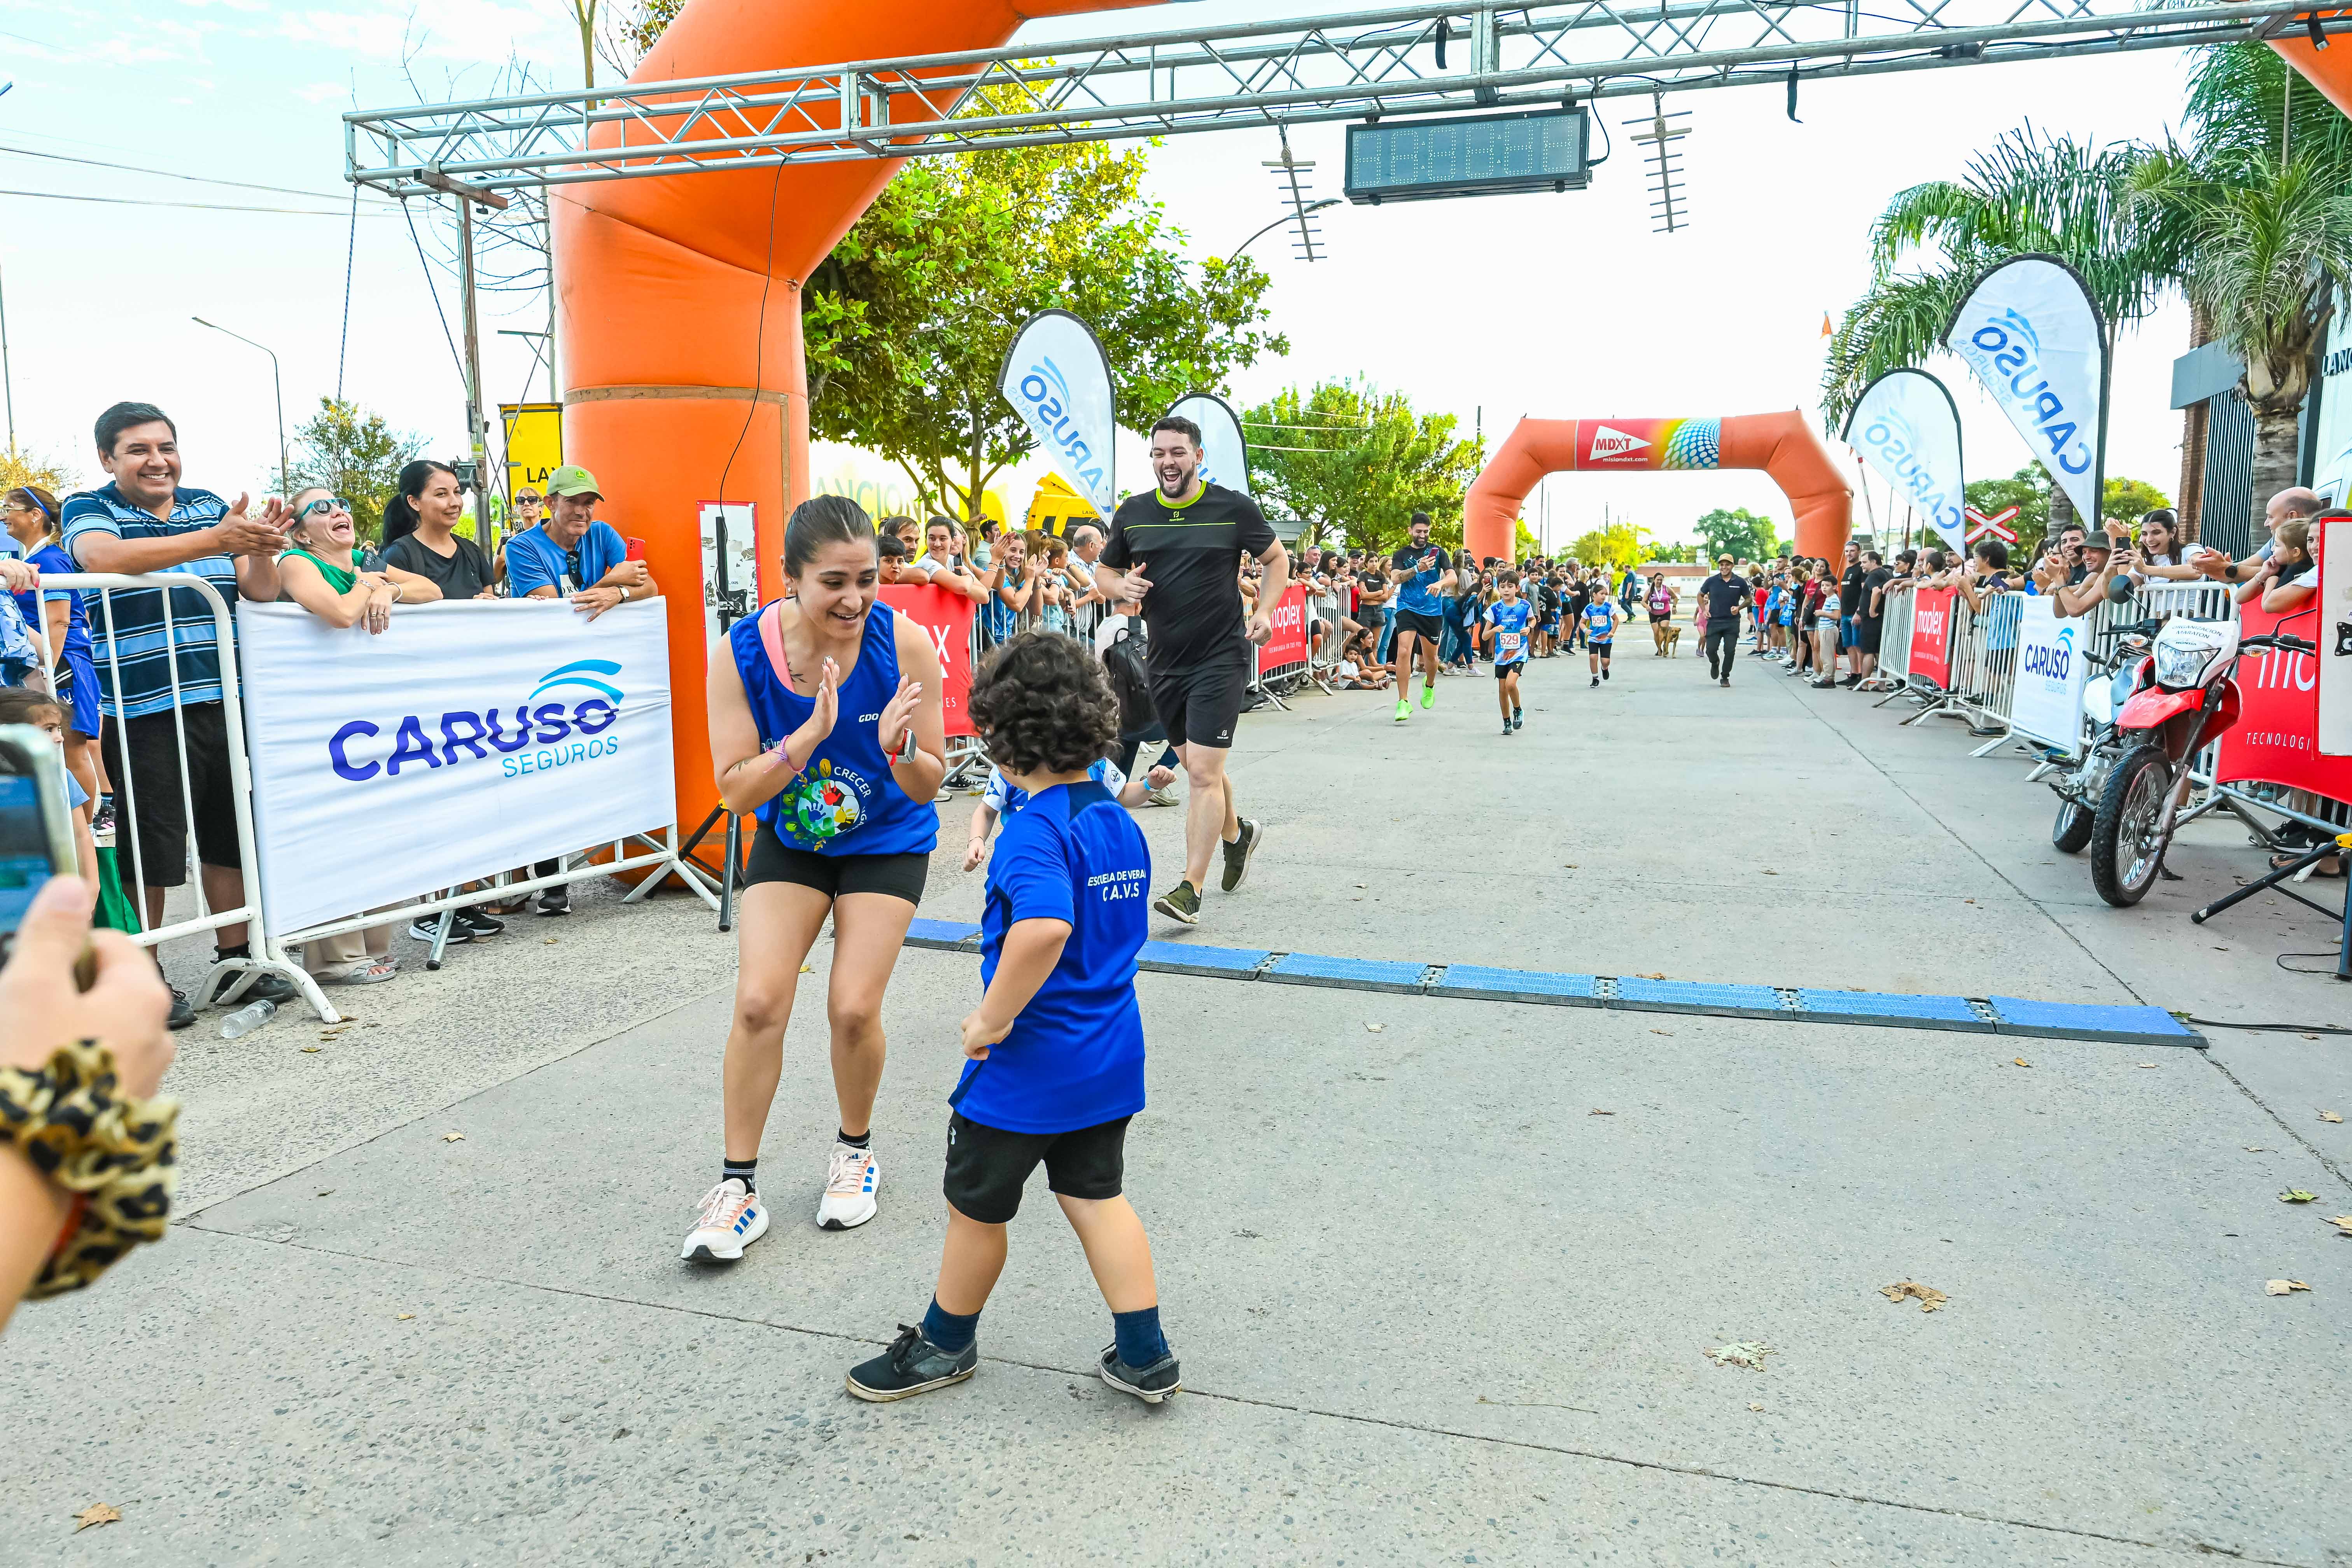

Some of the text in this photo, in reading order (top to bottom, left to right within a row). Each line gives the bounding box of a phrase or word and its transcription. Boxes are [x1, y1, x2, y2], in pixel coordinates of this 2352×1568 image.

[1916, 602, 1944, 642] moplex
[2172, 625, 2222, 636] ORGANIZACION
[2176, 630, 2210, 639] MARATON
[1501, 634, 1519, 645] 529
[2025, 644, 2069, 680] CARUSO
[328, 699, 619, 781] CARUSO
[2246, 732, 2310, 751] TECNOLOGI
[504, 736, 618, 778] SEGUROS
[834, 766, 871, 798] CRECER
[1087, 872, 1115, 886] ESCUELA
[1116, 870, 1127, 881] DE
